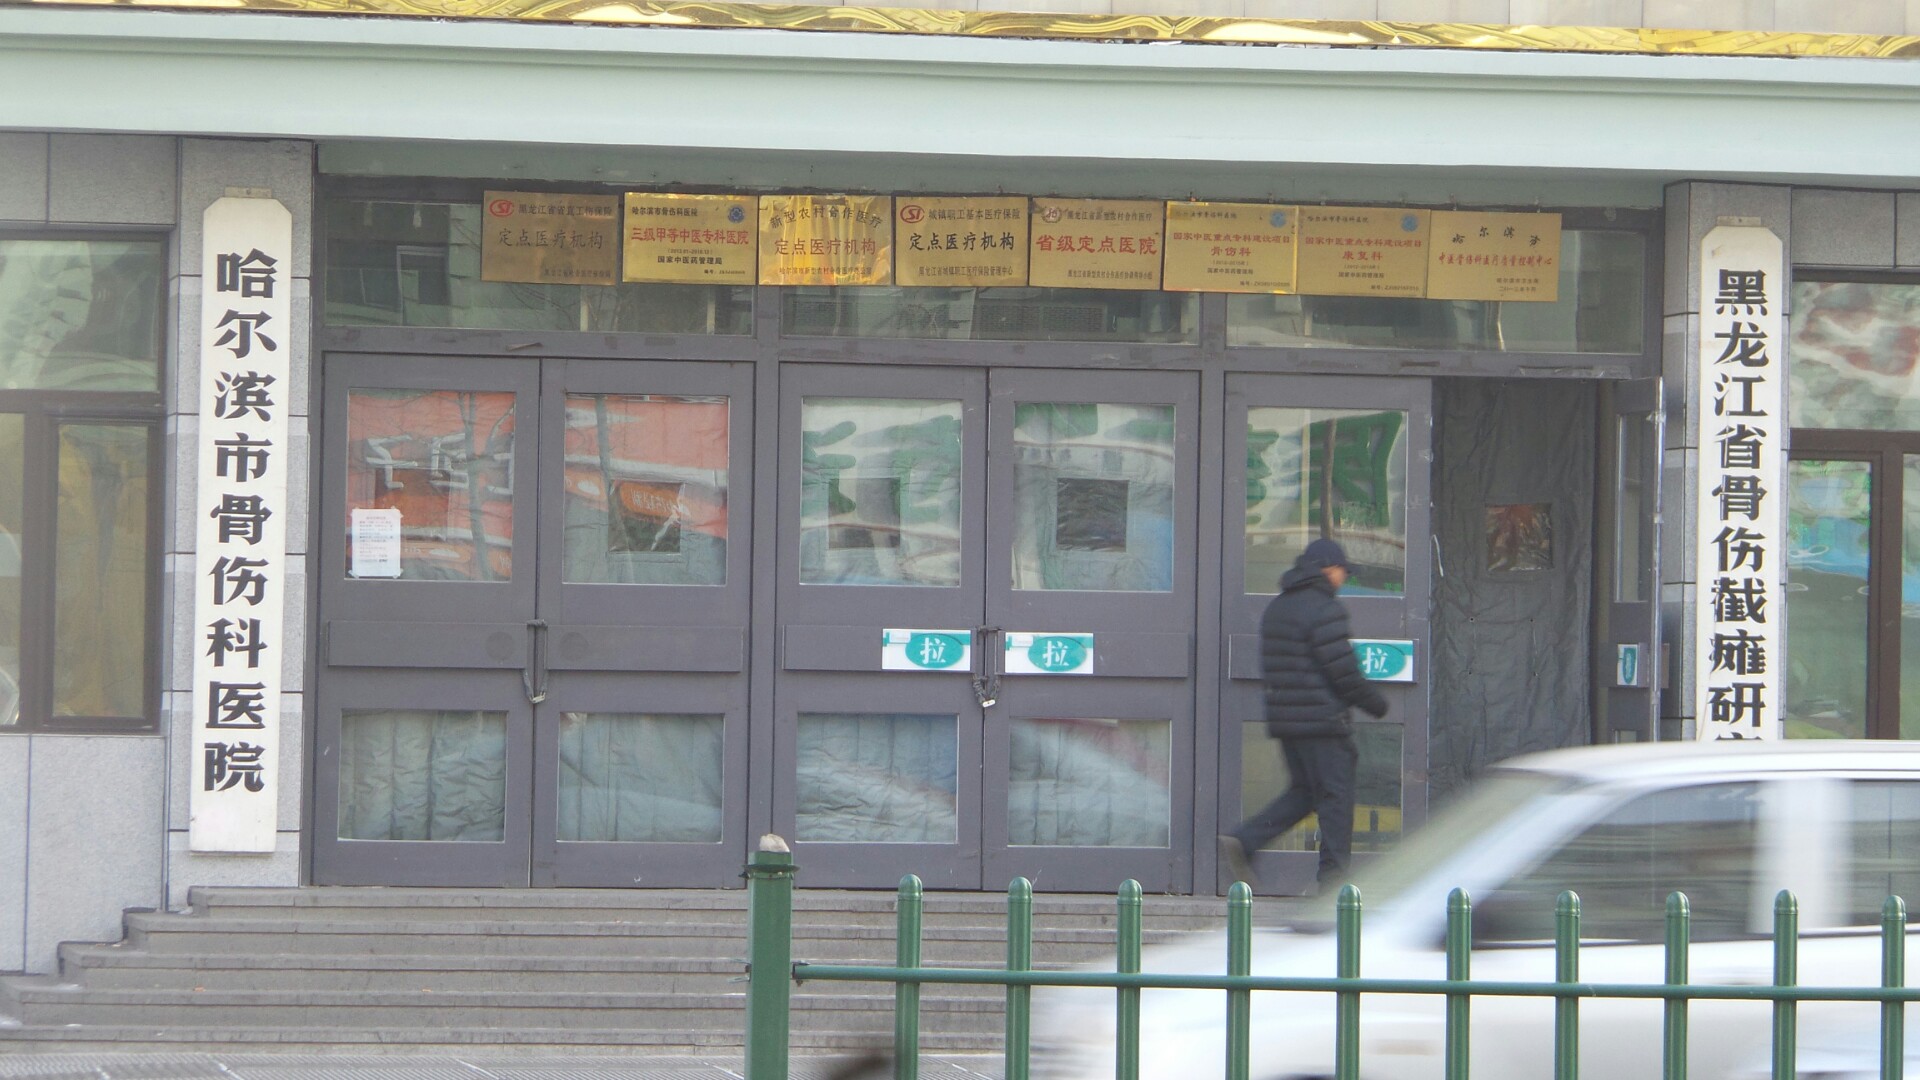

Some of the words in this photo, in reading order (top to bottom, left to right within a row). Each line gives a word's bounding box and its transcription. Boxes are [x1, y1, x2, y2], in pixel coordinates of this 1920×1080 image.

[631, 206, 698, 217] 哈尔滨市骨伤科医院
[770, 206, 883, 229] 新型农村合作医疗
[928, 208, 1021, 221] 城镇职工基本医疗保险
[499, 228, 603, 249] 定点医疗机构
[631, 227, 749, 245] 三级甲等中医专科医院
[909, 231, 1015, 252] 定点医疗机构
[1036, 234, 1158, 256] 省级定点医院
[1173, 232, 1290, 244] 国家中医重点专科建设项目
[1305, 236, 1422, 248] 国家中医重点专科建设项目
[774, 238, 876, 256] 定点医疗机构
[1211, 246, 1252, 257] 骨伤科
[1342, 250, 1383, 261] 康复科
[657, 255, 723, 265] 国家中医药管理局
[1707, 268, 1770, 740] 黑龙江省骨伤截瘫研
[203, 248, 278, 793] 哈尔滨市骨伤科医院
[919, 637, 947, 665] 拉
[1042, 640, 1070, 667] 拉
[1361, 646, 1389, 674] 拉
